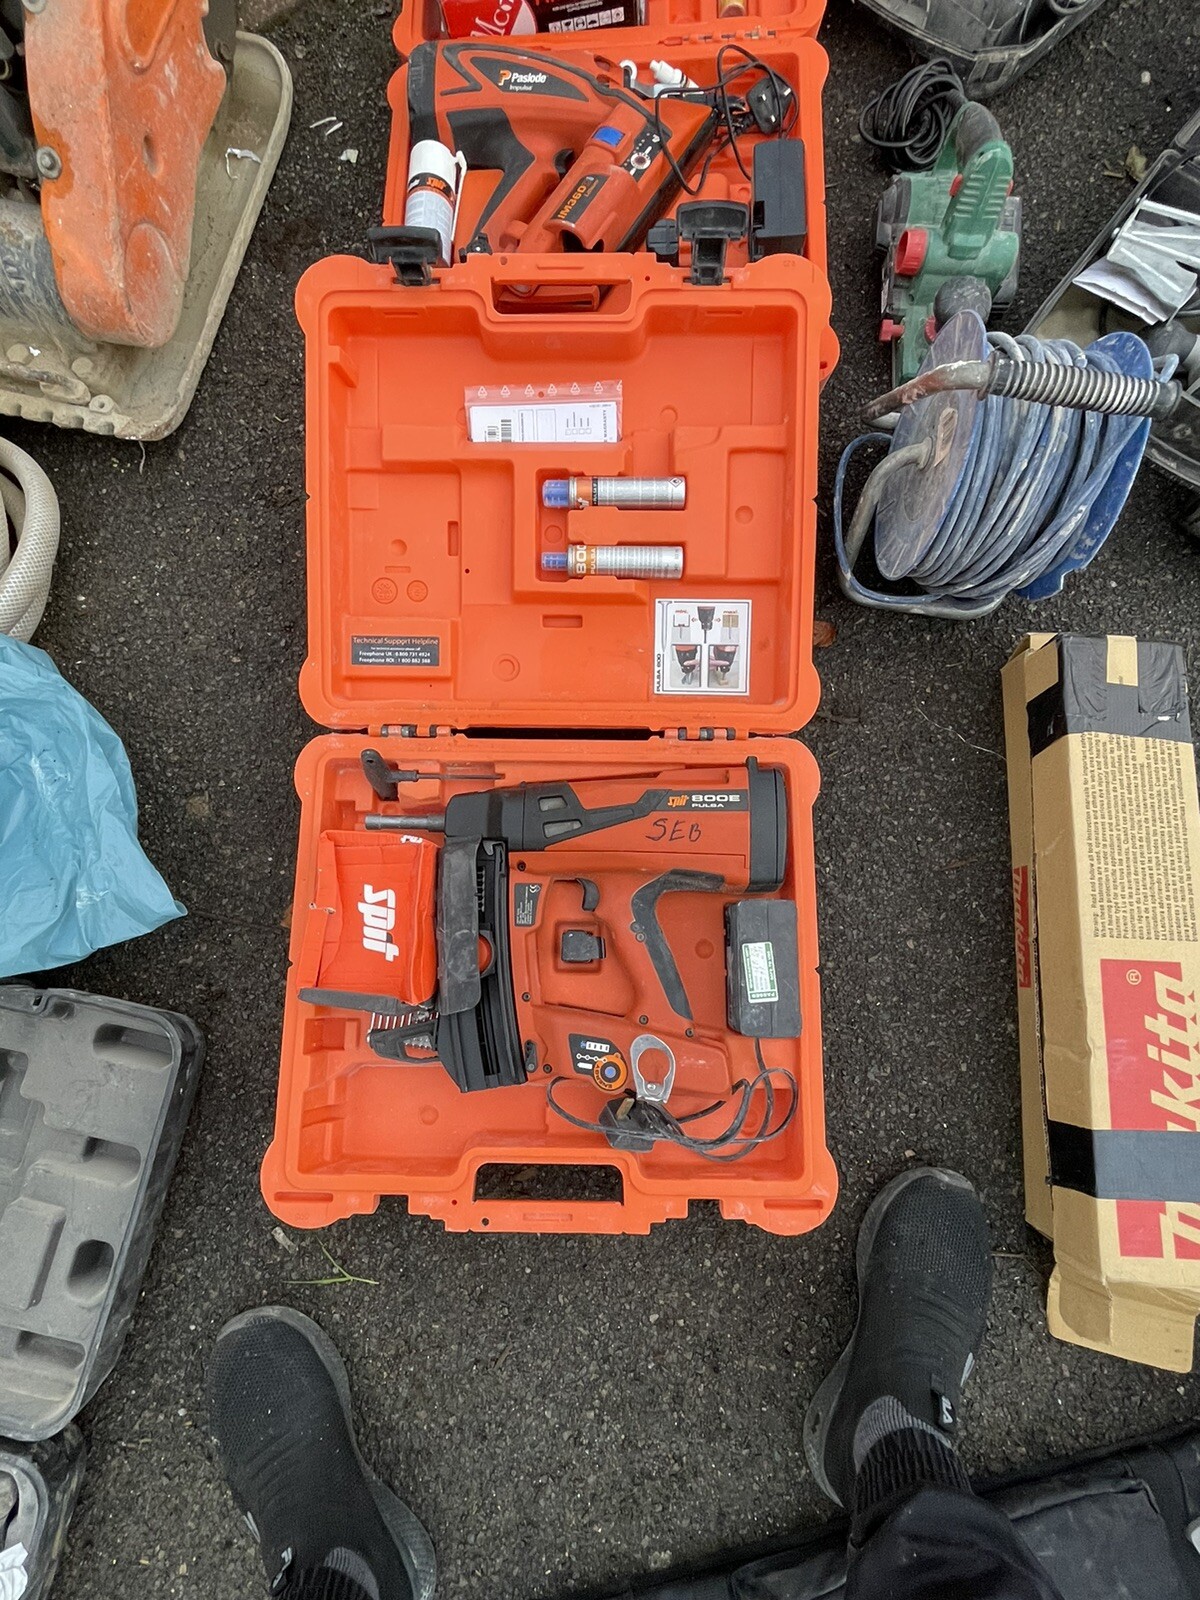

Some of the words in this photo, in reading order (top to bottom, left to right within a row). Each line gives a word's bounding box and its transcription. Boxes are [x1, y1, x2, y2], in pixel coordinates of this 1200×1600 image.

[511, 72, 546, 84] Paslode
[384, 638, 410, 646] Support
[668, 794, 690, 808] spit
[646, 818, 702, 842] SEB
[358, 884, 400, 962] spit
